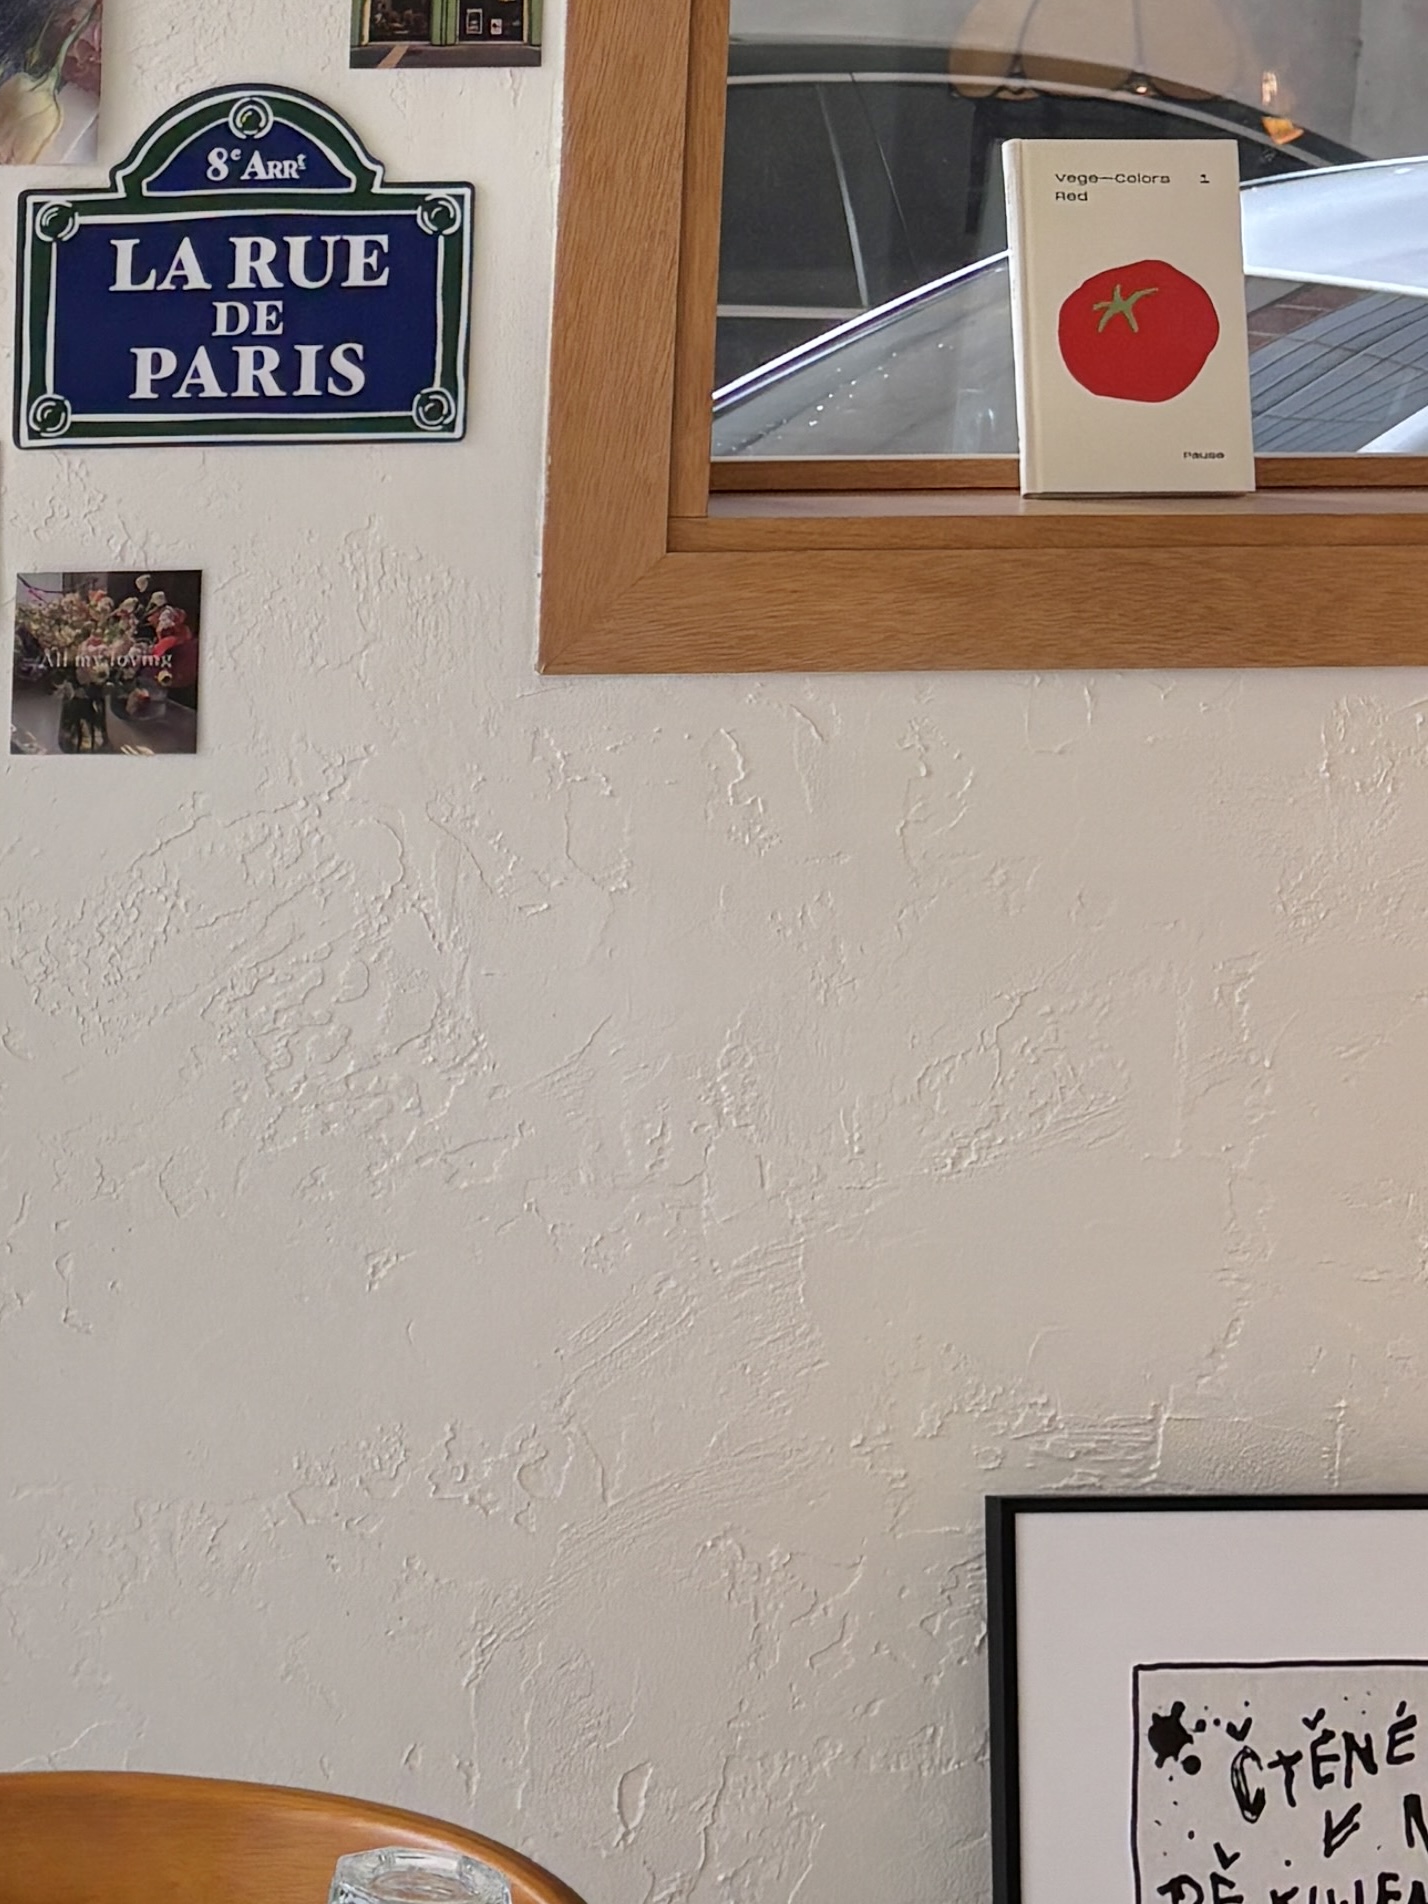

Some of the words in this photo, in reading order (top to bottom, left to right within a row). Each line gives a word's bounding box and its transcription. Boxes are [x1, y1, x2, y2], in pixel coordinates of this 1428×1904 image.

[1055, 191, 1088, 202] Red
[1200, 174, 1210, 184] 1
[108, 236, 212, 291] LA
[227, 234, 390, 289] RUE
[211, 301, 284, 337] DE
[128, 343, 366, 399] PARIS
